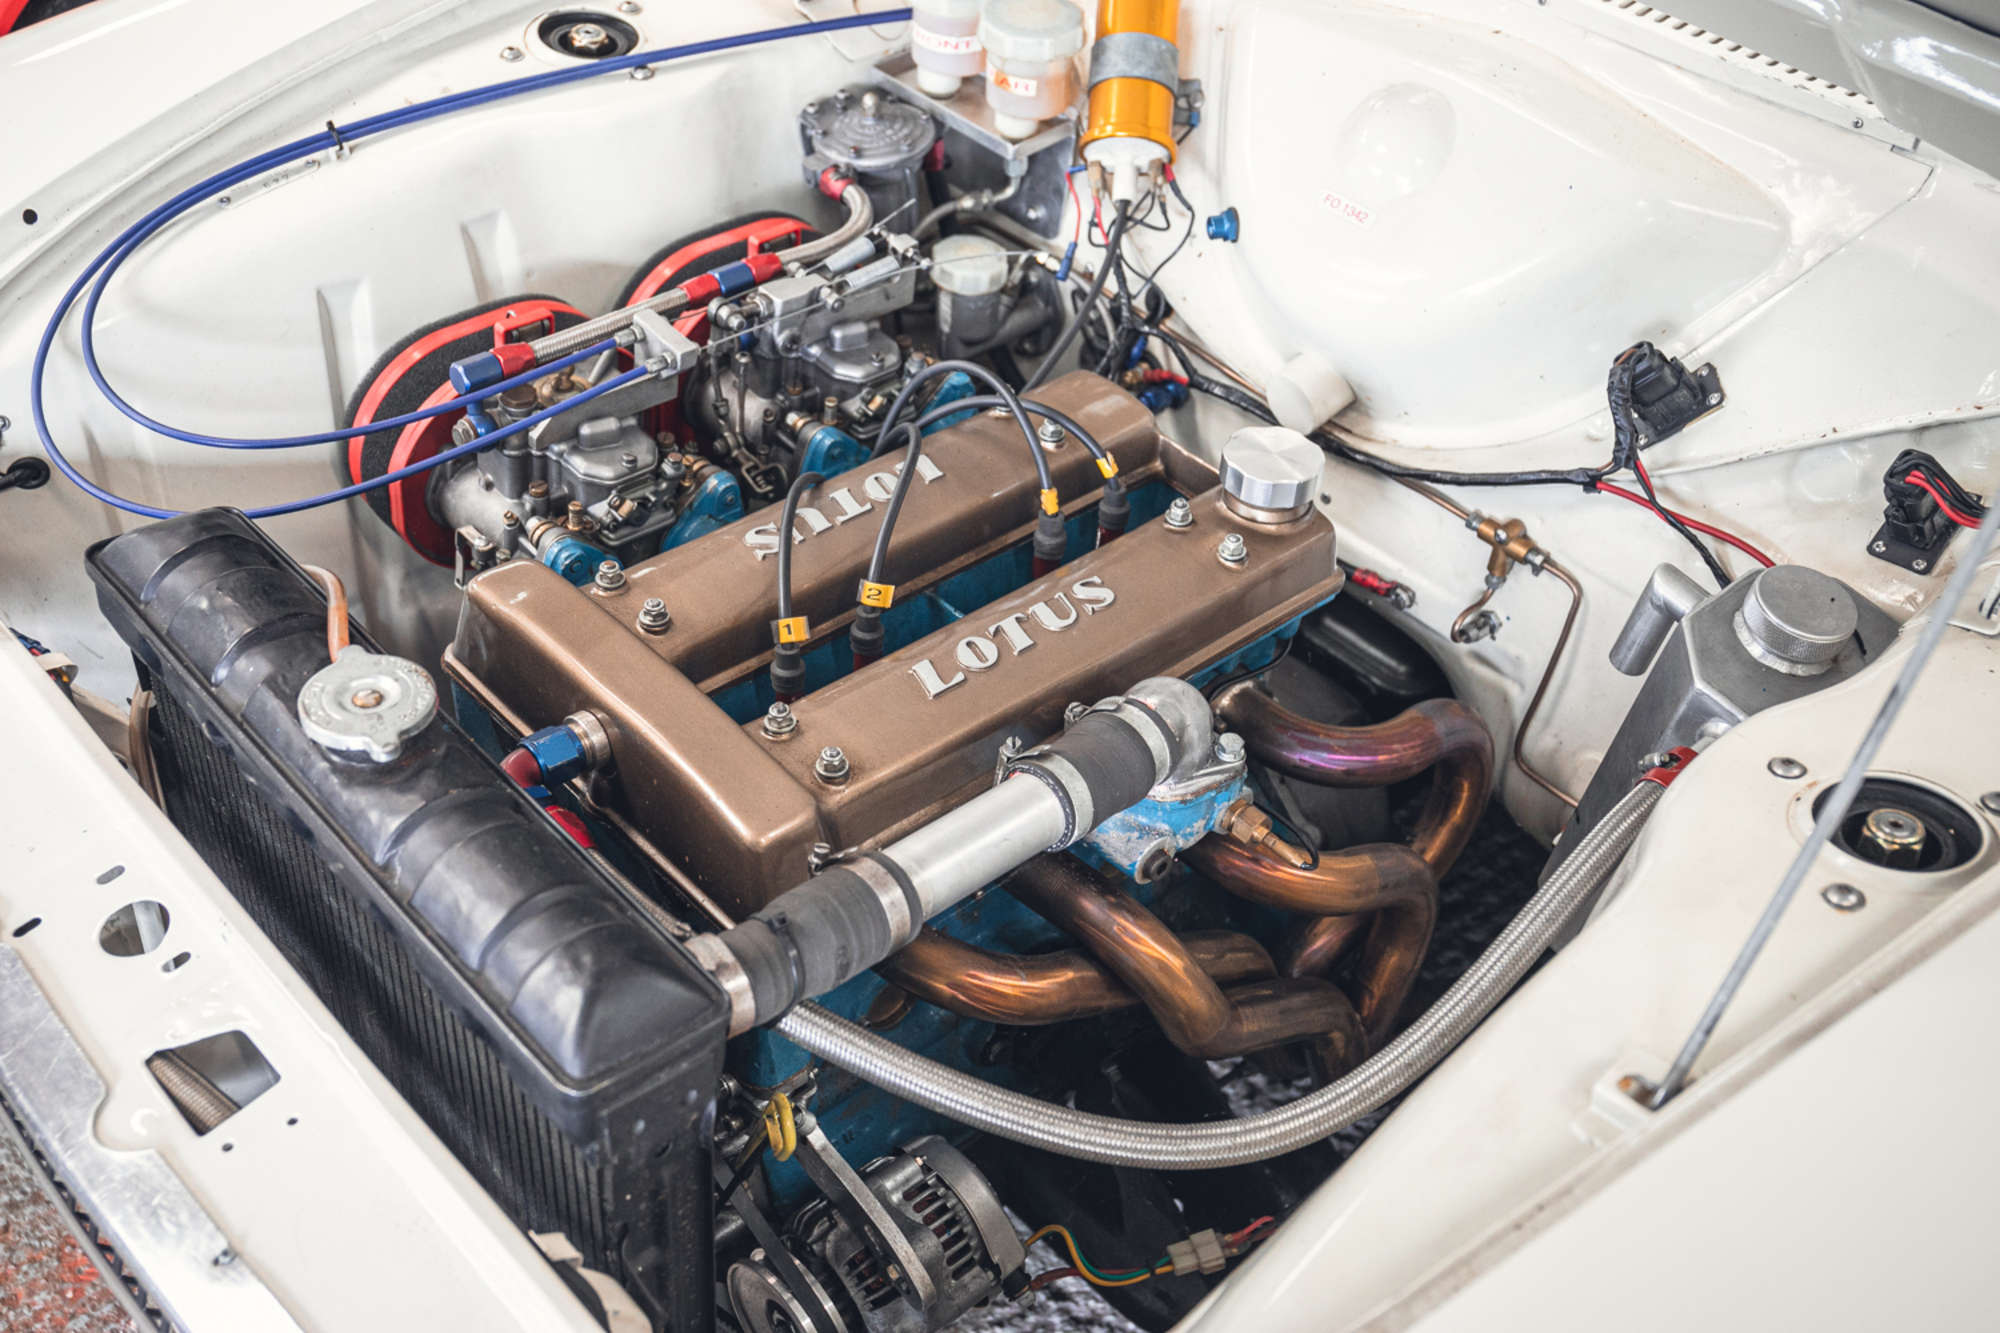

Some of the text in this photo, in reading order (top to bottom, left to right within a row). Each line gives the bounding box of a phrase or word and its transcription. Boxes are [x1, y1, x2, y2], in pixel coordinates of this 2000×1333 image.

[1343, 203, 1369, 224] 1342
[866, 587, 883, 601] 2
[782, 623, 793, 635] 1
[909, 575, 1116, 699] LOTUS
